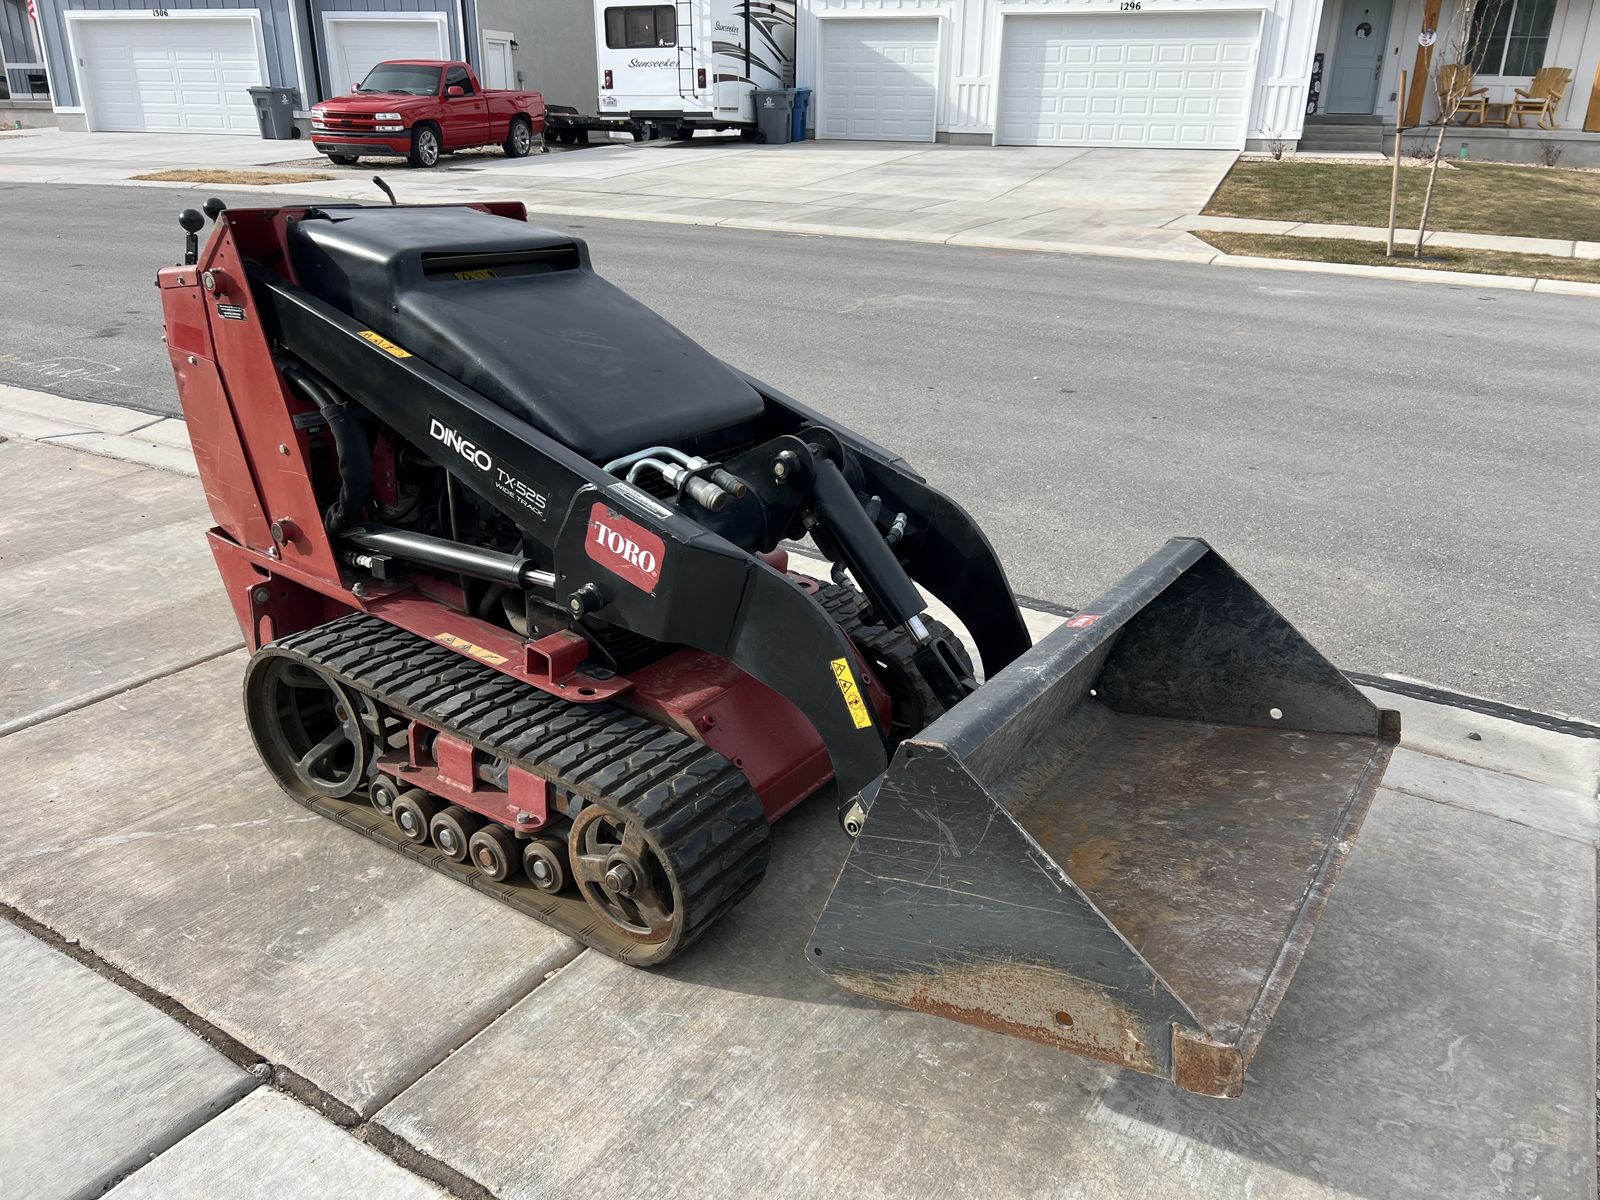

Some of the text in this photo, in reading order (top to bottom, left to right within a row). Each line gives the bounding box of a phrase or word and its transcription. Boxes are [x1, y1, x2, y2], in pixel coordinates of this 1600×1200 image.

[152, 9, 169, 17] 1306
[1120, 1, 1141, 11] 1296
[627, 57, 680, 69] Sunseeker
[429, 418, 492, 471] DINGO
[495, 481, 543, 517] WIDE TRACK
[594, 521, 656, 573] TORO
